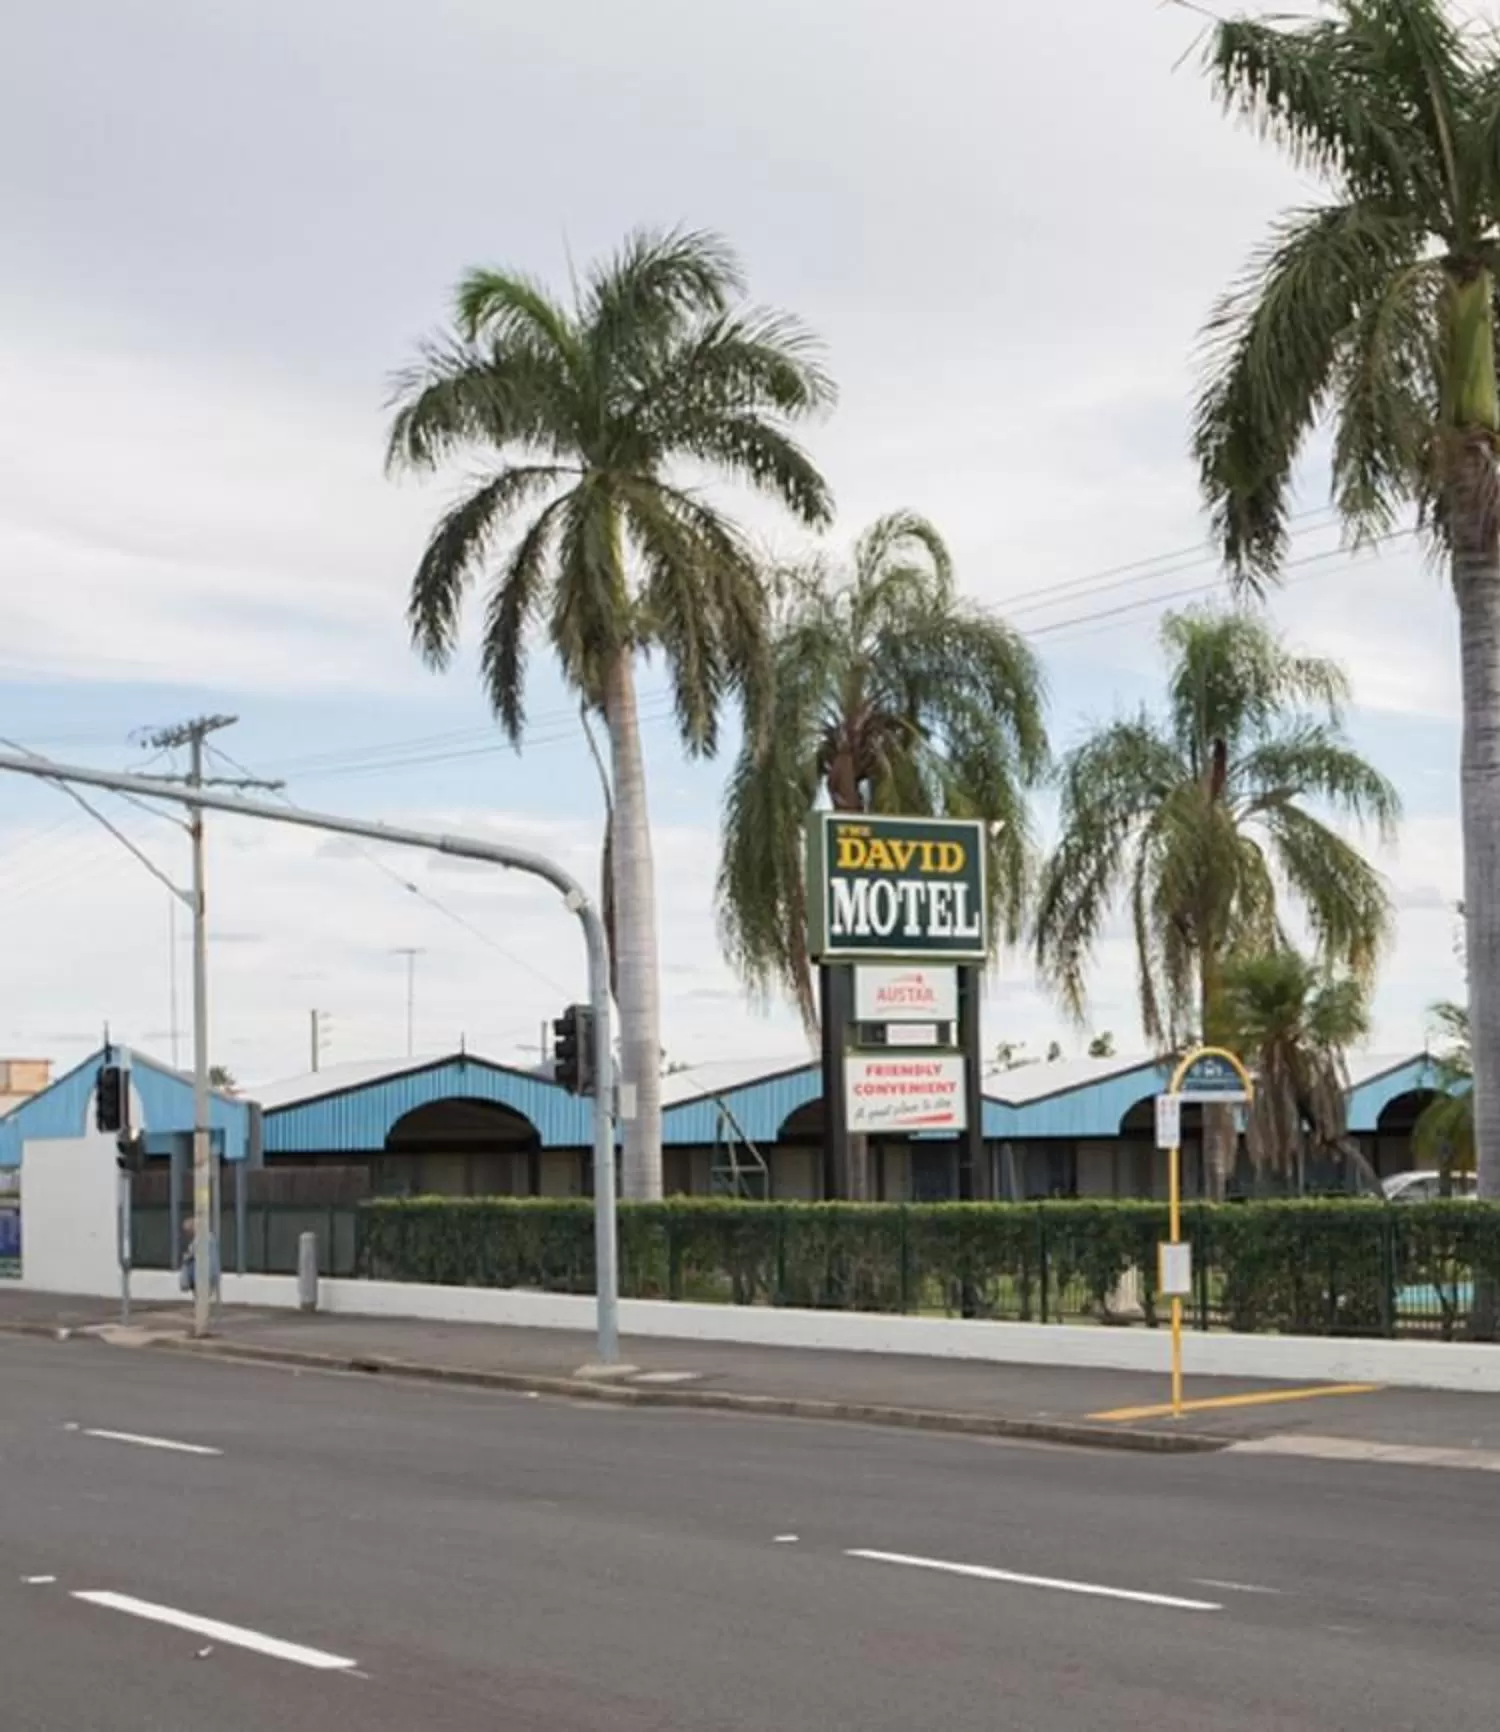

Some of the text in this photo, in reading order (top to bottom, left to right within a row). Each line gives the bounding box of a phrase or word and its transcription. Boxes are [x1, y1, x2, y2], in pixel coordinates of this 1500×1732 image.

[837, 838, 966, 873] DAVID
[831, 877, 979, 938] MOTEL
[865, 1064, 942, 1077] FRIENDLY
[854, 1082, 956, 1096] CONVENIENT
